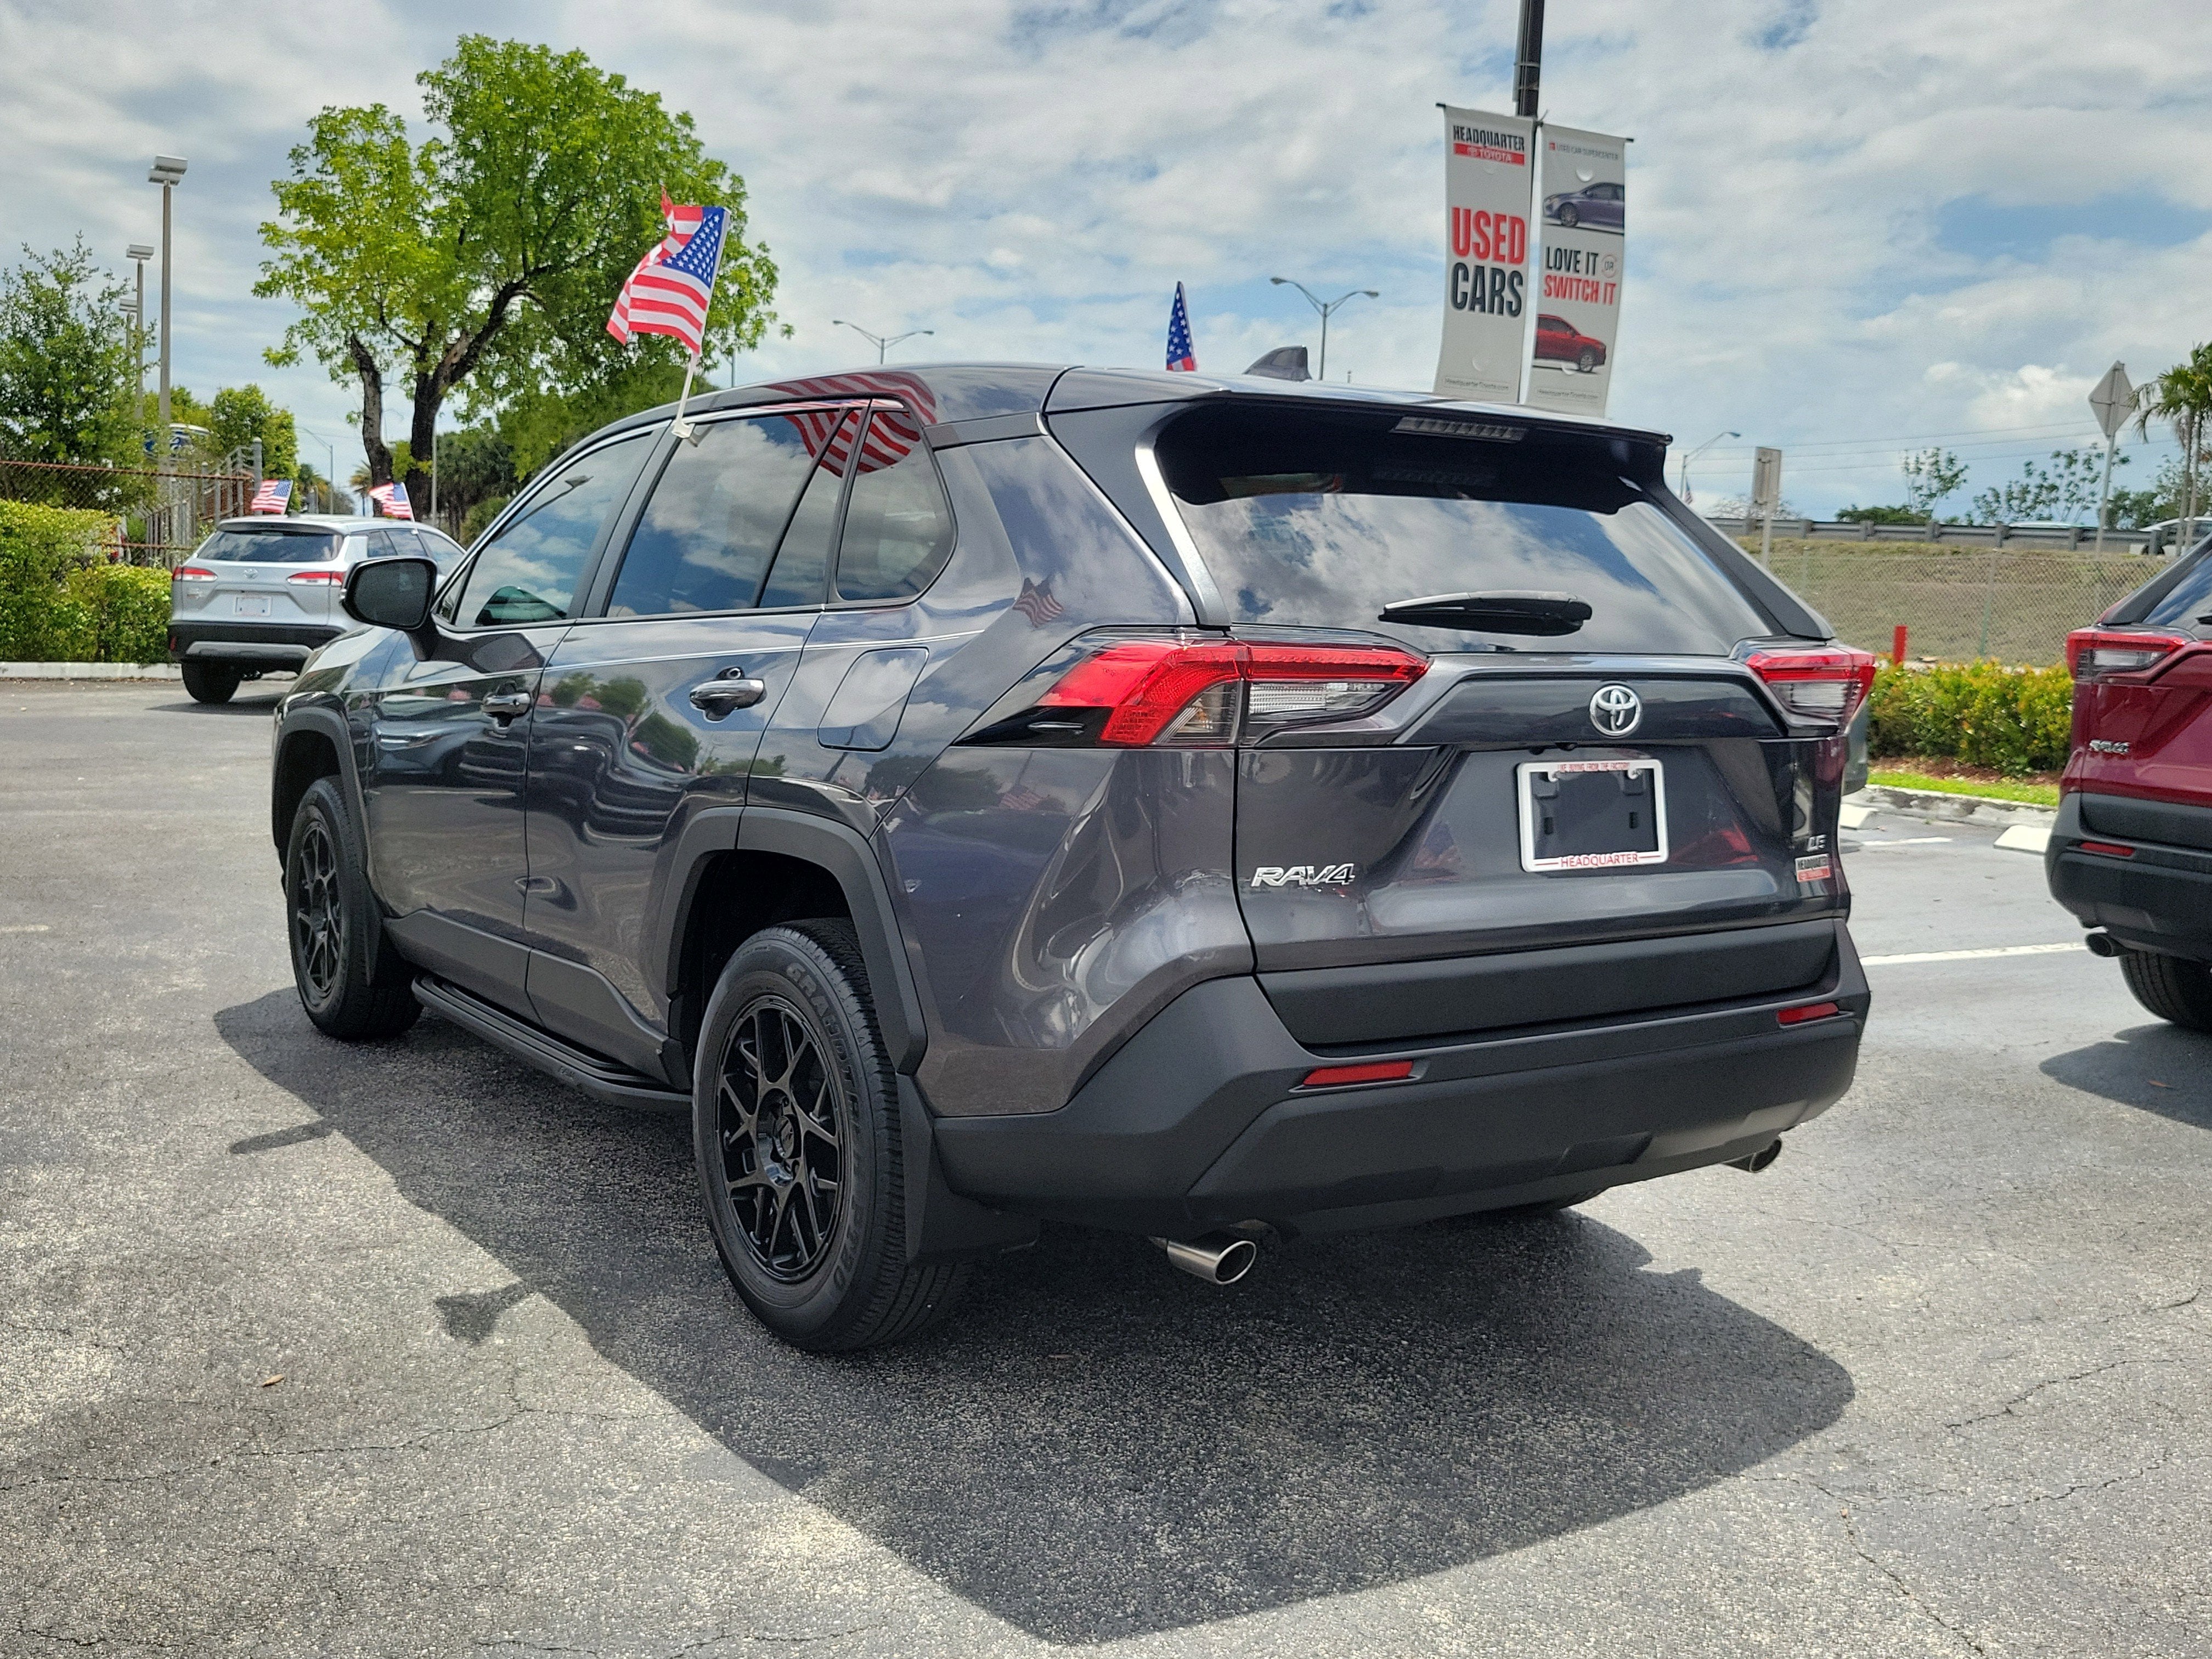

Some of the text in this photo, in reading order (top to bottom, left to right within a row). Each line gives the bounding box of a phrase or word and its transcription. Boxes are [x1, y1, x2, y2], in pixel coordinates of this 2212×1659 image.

[1453, 125, 1525, 151] HEADQUARTER
[1480, 149, 1512, 163] TOYOTA
[1451, 206, 1526, 265] USED
[1546, 246, 1614, 276] LOVE IT OR
[1451, 262, 1523, 318] CARS
[1544, 275, 1616, 305] SWITCH IT
[1806, 834, 1827, 852] LE
[1561, 853, 1639, 868] HEADQUARTER
[1251, 863, 1355, 887] RAV4
[787, 962, 861, 1141] GRANDTR
